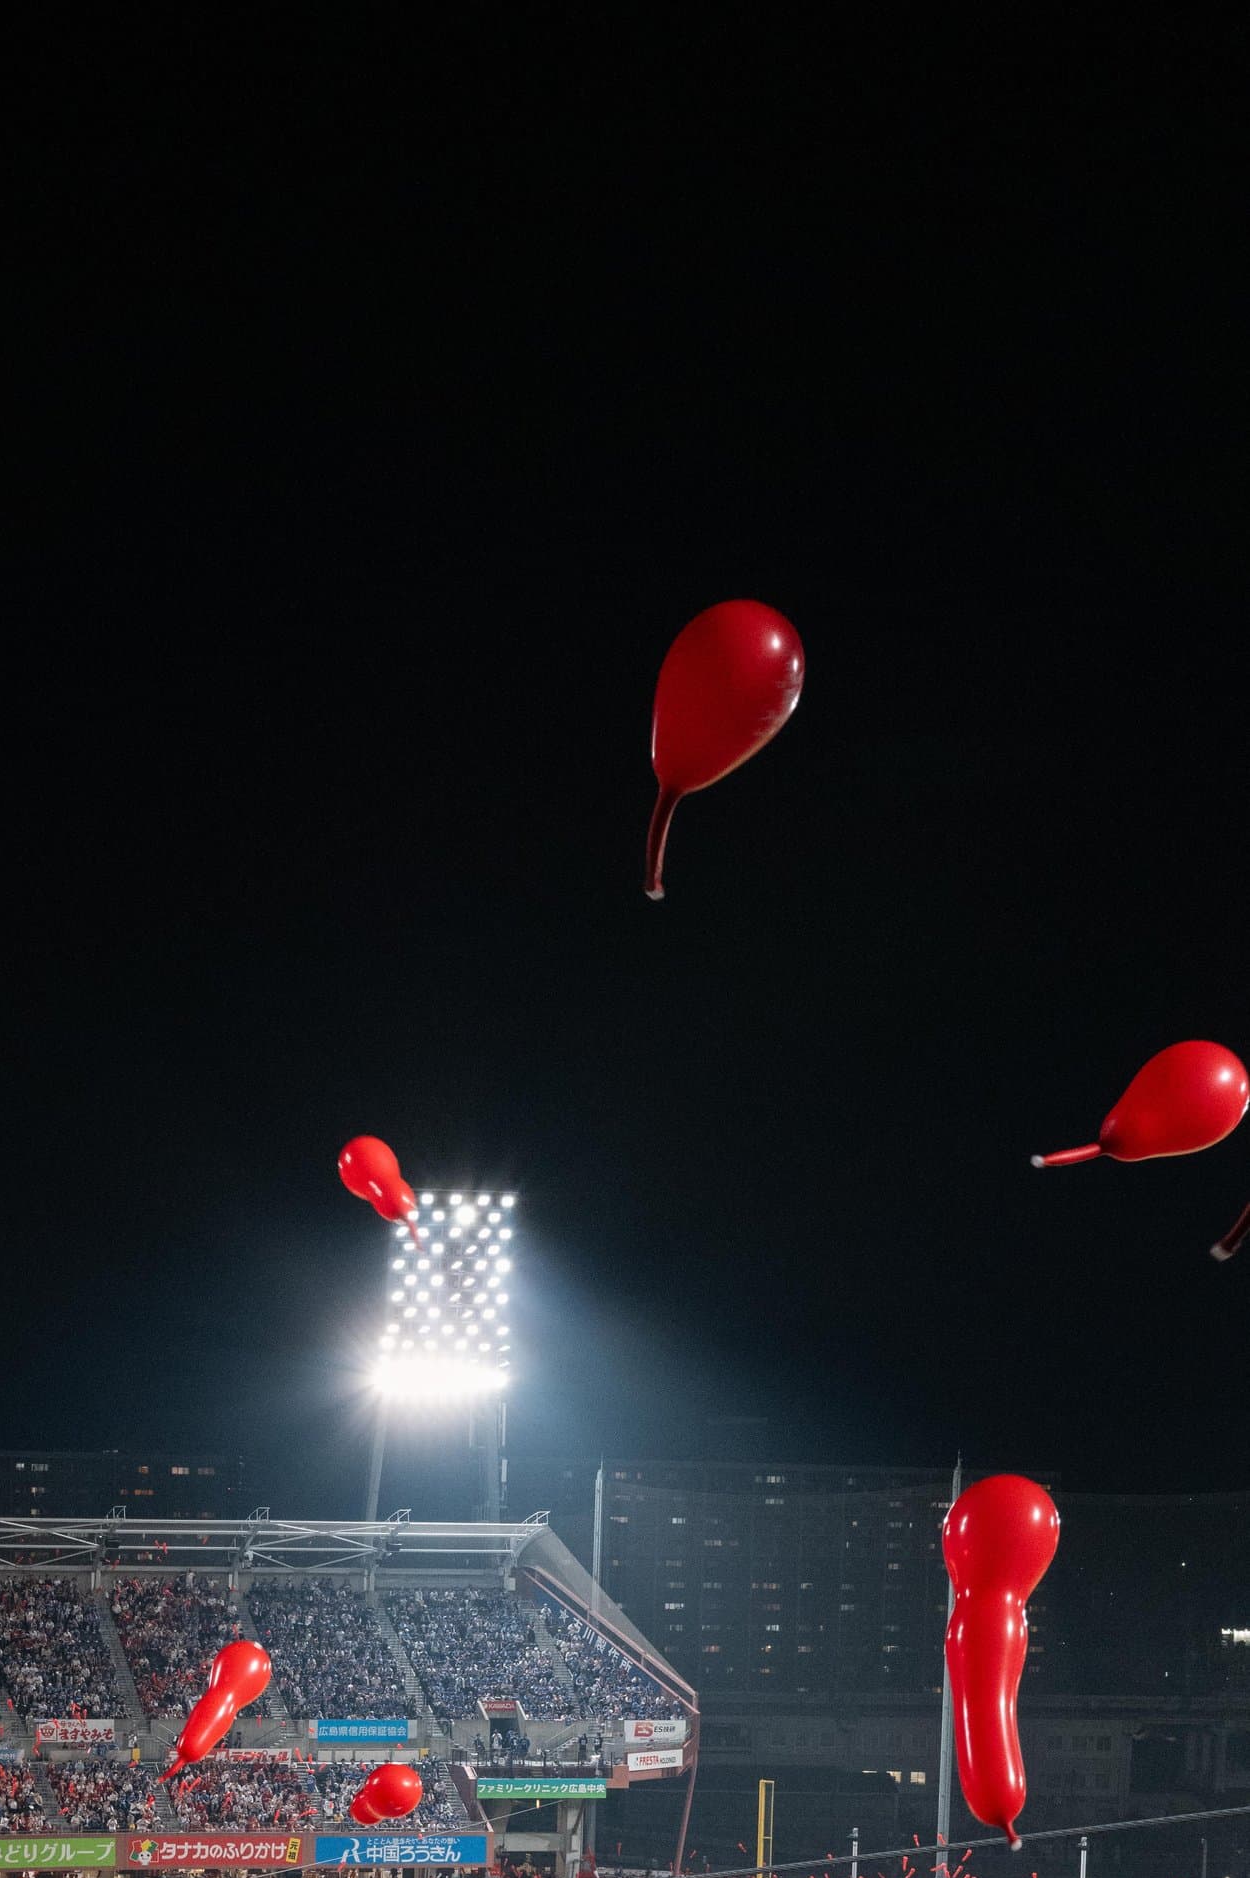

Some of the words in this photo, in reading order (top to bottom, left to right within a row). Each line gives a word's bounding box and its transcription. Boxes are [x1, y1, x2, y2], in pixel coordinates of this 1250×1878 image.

[59, 1728, 114, 1740] ますやみそ
[318, 1726, 407, 1737] 広島県信用保証協会
[477, 1783, 606, 1794] ファミリークリニック広島中央
[160, 1841, 287, 1860] タナカのふりかけ
[366, 1845, 461, 1863] 中国ろうきん
